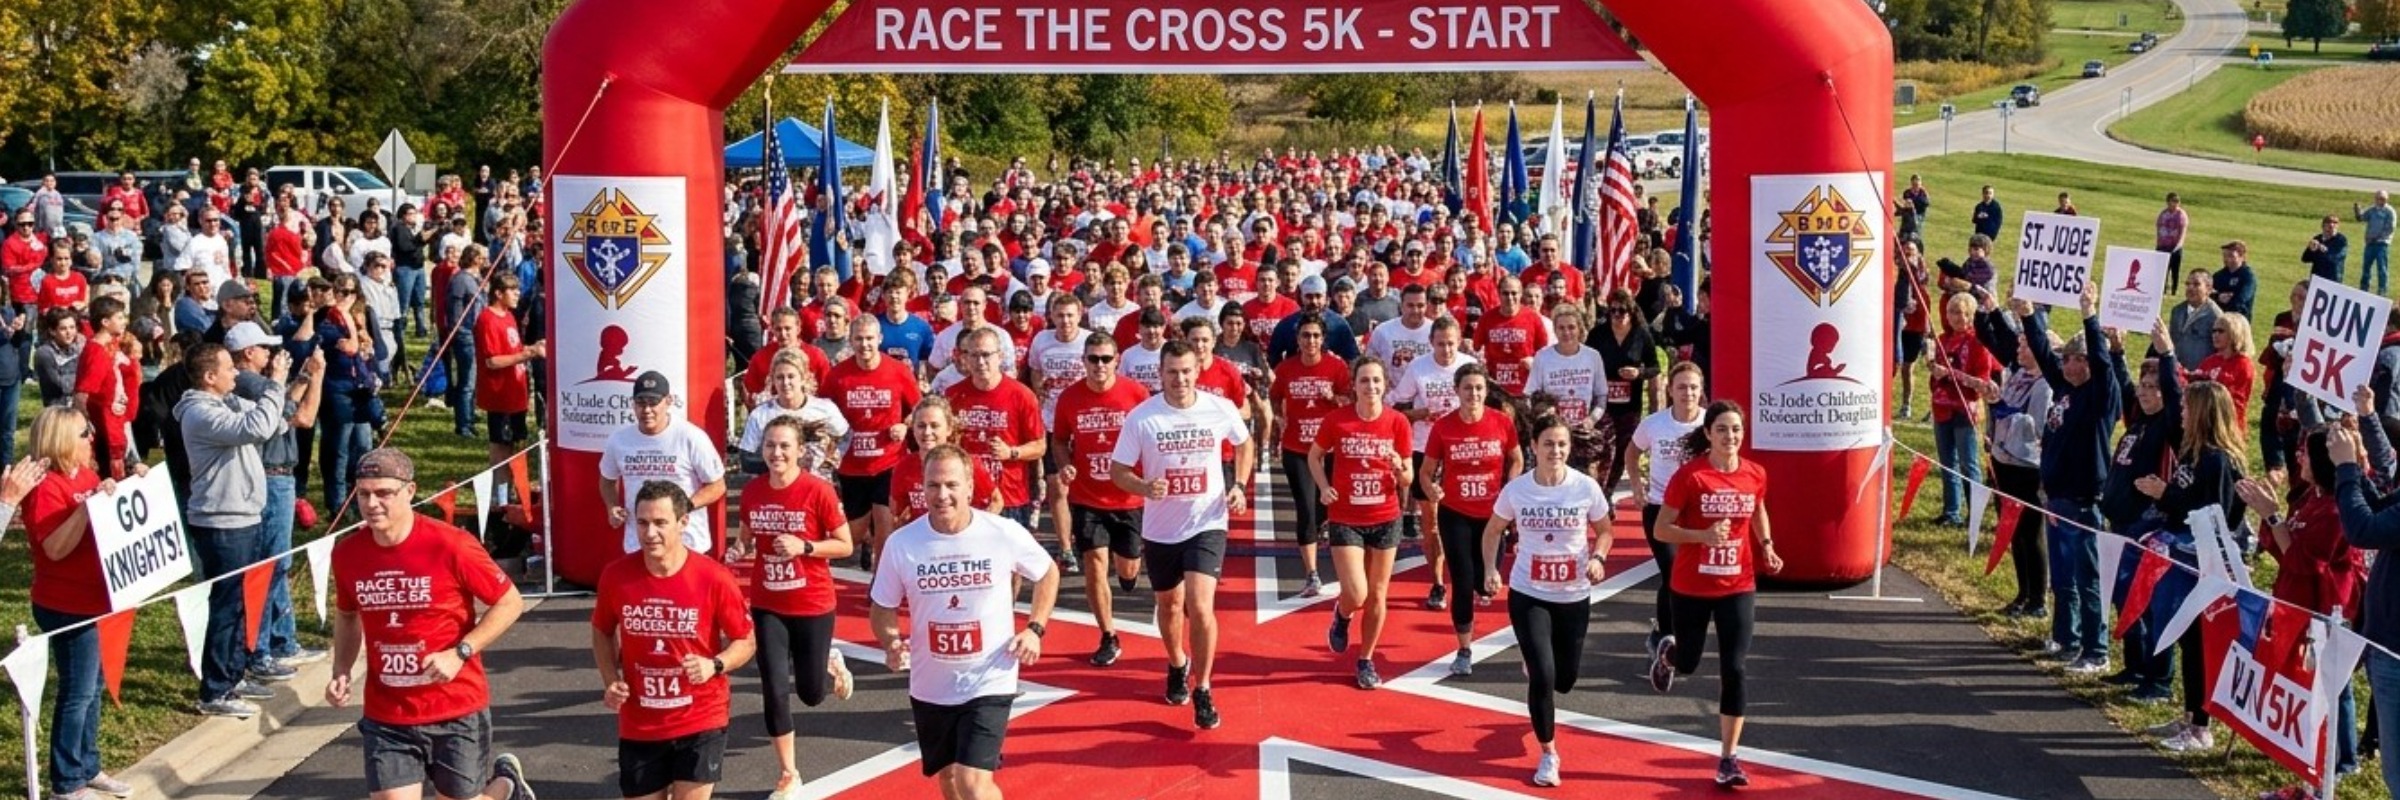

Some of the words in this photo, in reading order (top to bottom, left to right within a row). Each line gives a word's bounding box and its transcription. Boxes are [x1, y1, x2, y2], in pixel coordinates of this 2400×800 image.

[876, 7, 1003, 51] RACE
[1016, 8, 1111, 51] THE
[1125, 7, 1288, 51] CROSS
[1302, 7, 1365, 50] 5K
[1409, 5, 1561, 50] START
[2023, 221, 2045, 252] ST.
[2017, 258, 2085, 295] HEROES
[2307, 287, 2376, 349] RUN
[2300, 337, 2356, 401] 5K
[116, 489, 149, 532] GO
[104, 520, 183, 593] KNIGHTS!
[961, 559, 992, 572] THE
[2266, 684, 2307, 748] 5K
